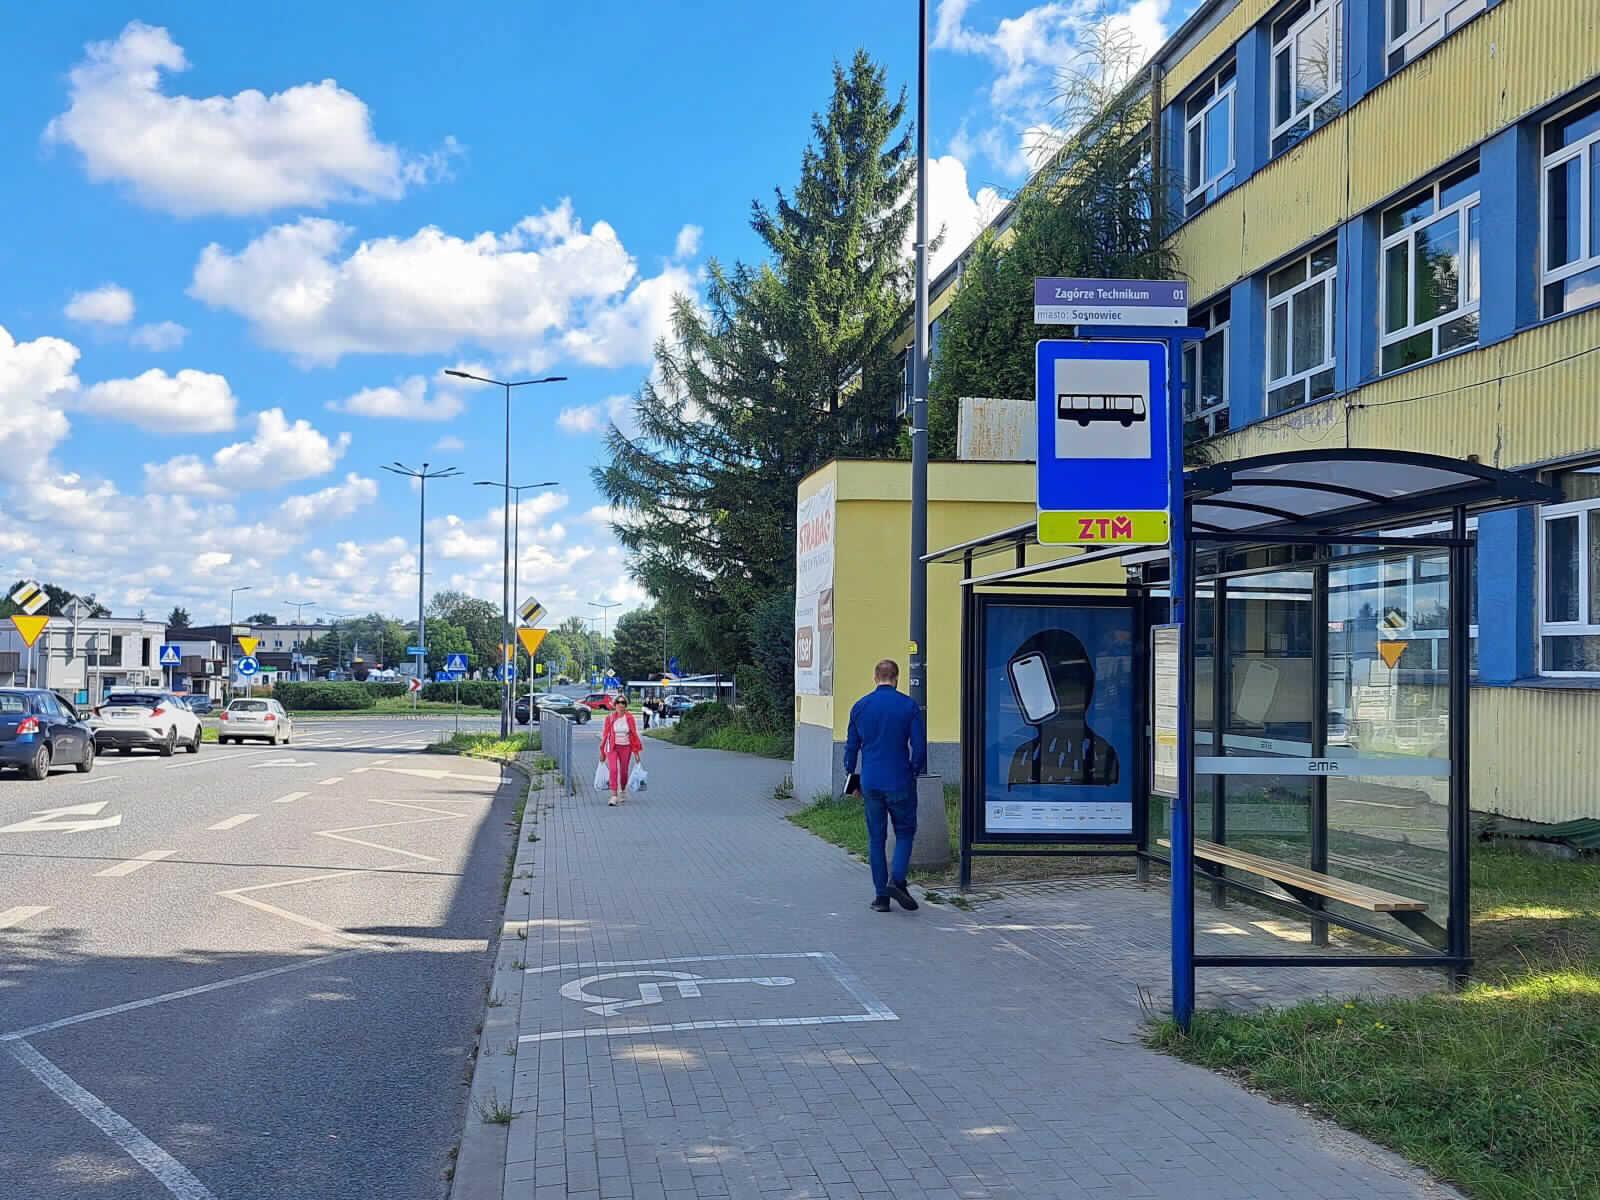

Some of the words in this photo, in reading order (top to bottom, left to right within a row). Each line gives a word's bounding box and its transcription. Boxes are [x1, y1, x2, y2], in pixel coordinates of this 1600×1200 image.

[1055, 287, 1095, 302] Zagórze
[1096, 288, 1150, 300] Technikum
[1173, 289, 1184, 300] 01
[1037, 311, 1069, 320] miasto:
[1071, 310, 1122, 320] Sosnowiec
[1078, 515, 1132, 539] ZTM
